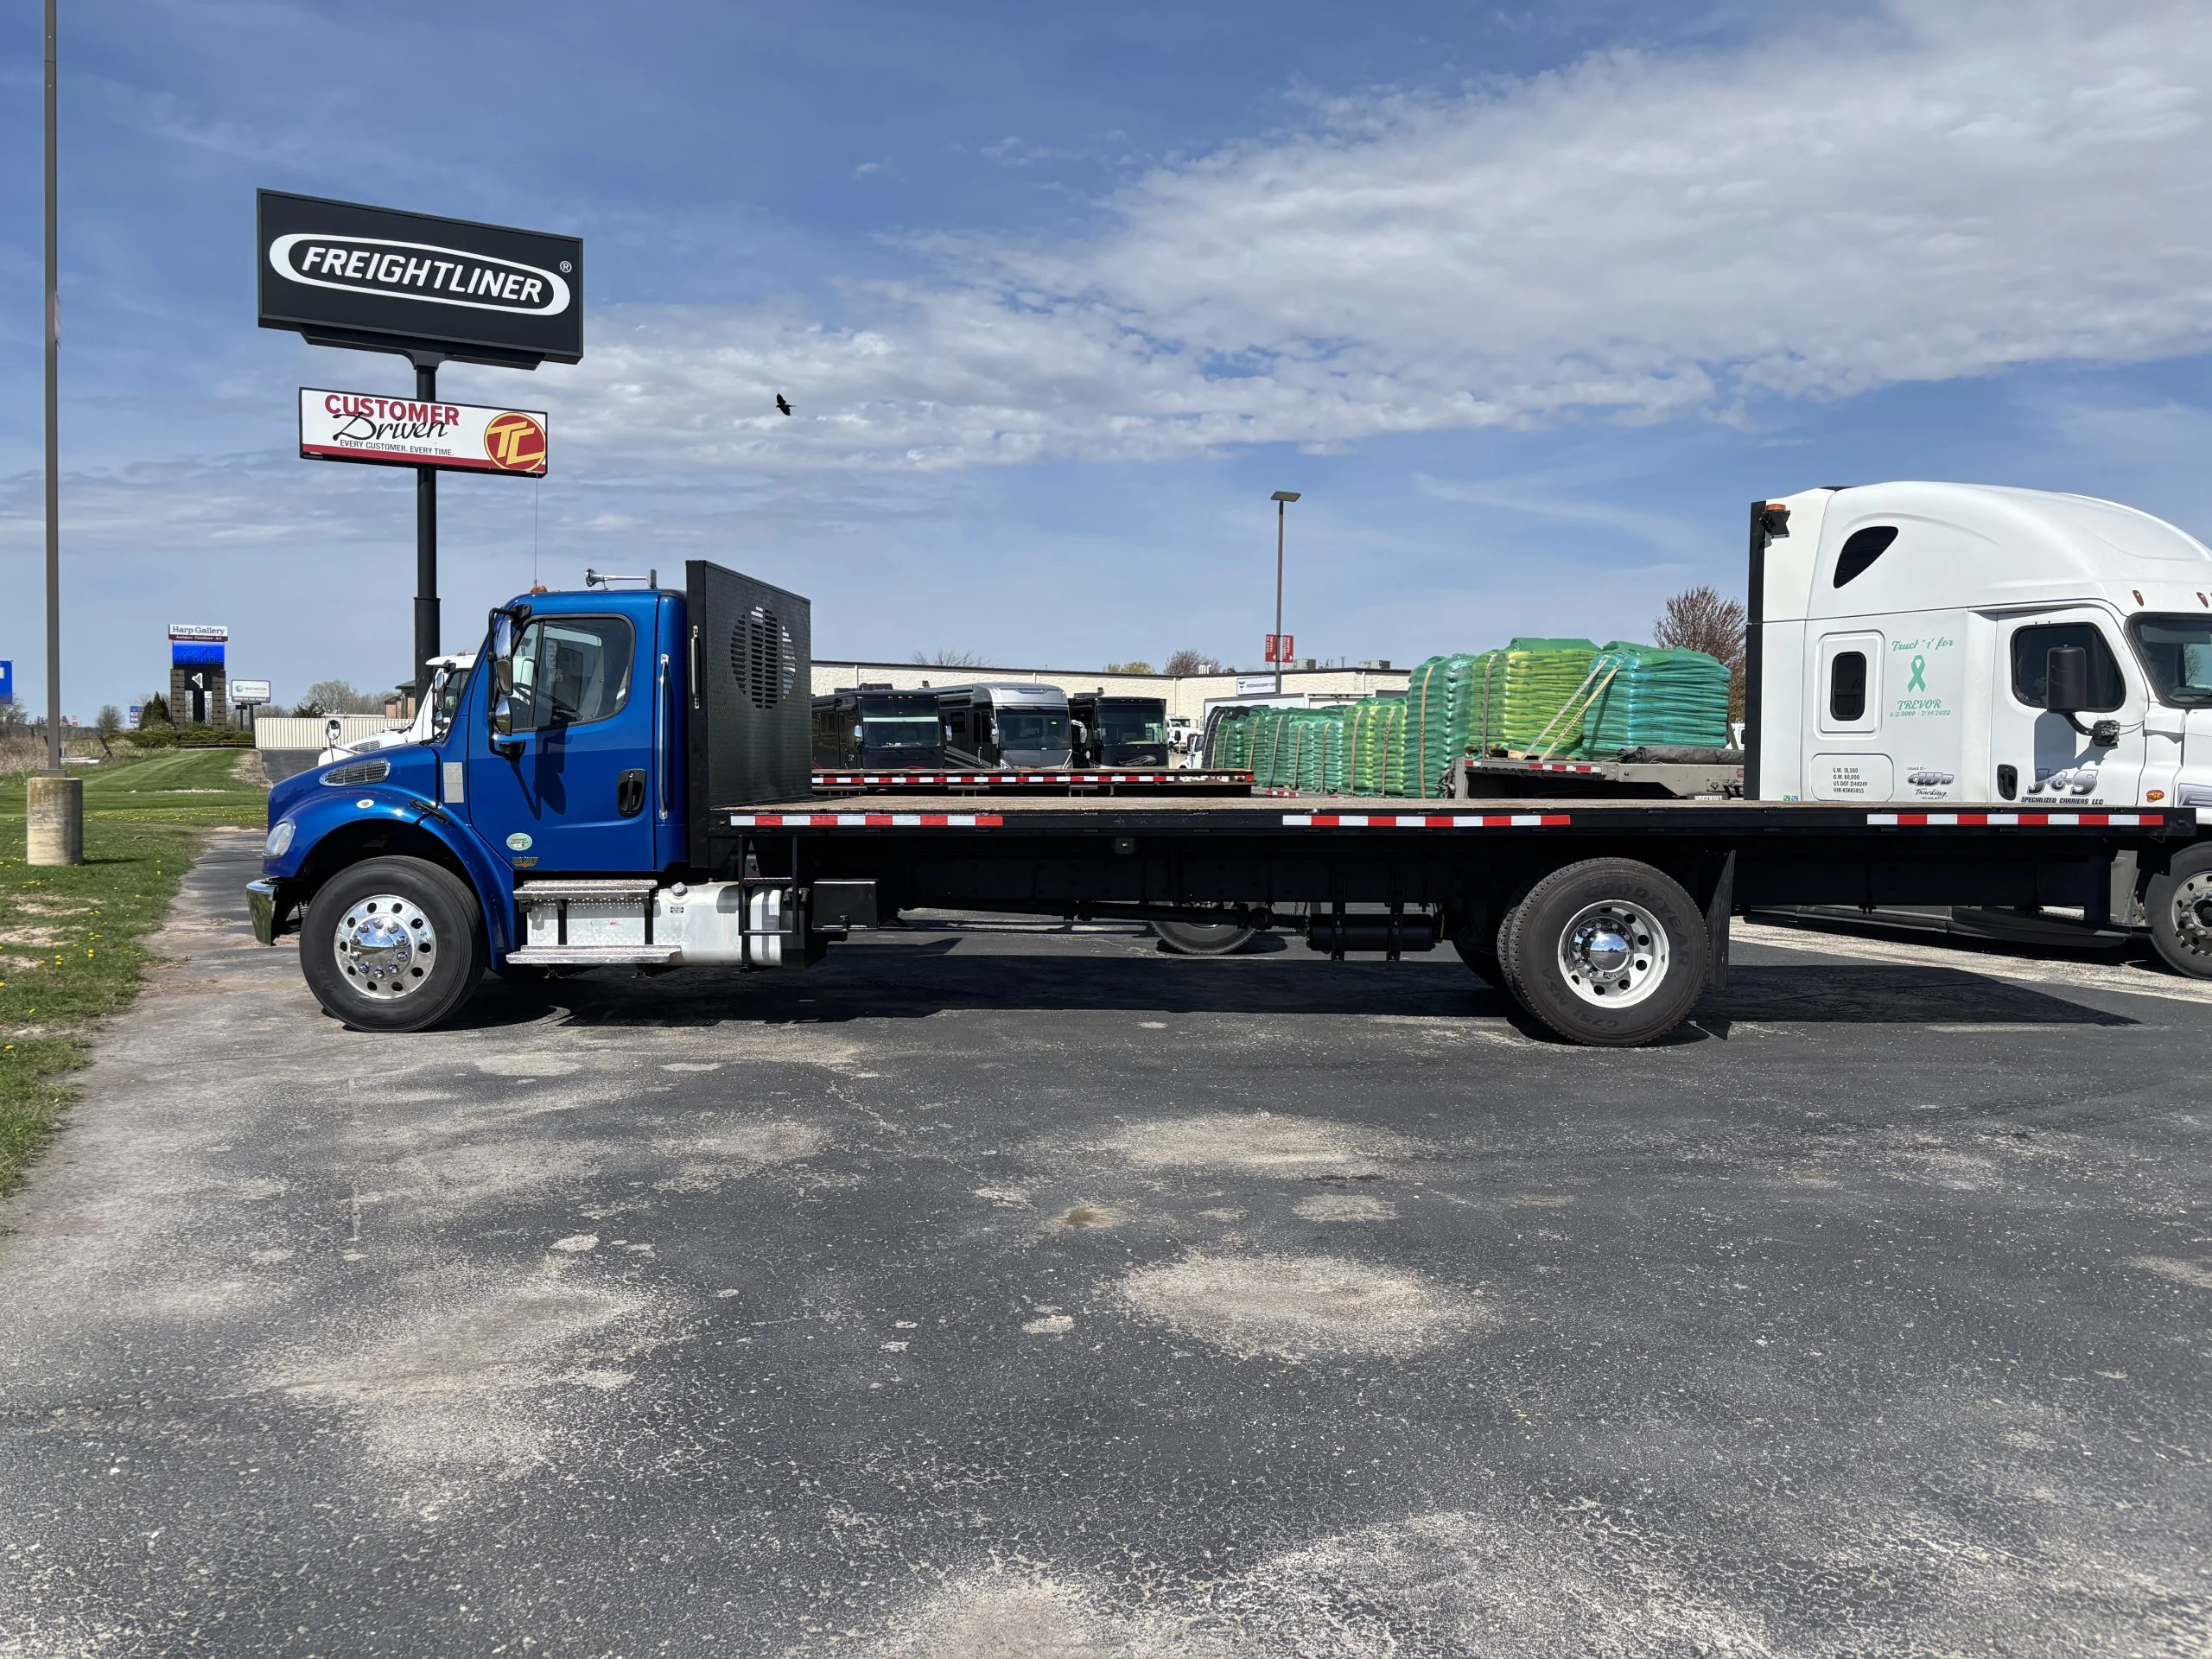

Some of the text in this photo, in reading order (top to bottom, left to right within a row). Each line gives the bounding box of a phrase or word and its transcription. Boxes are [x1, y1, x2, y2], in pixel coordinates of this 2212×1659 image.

[302, 246, 543, 302] FREIGHTLINER
[325, 394, 460, 426] CUSTOMER
[333, 411, 448, 442] Driven
[340, 439, 454, 456] EVERY CUSTOMER. EVERY TIME.
[172, 626, 225, 635] Harp Gallery
[1935, 636, 1954, 650] for
[1897, 699, 1942, 710] TREVOR
[1585, 882, 1690, 966] GOODYEAR
